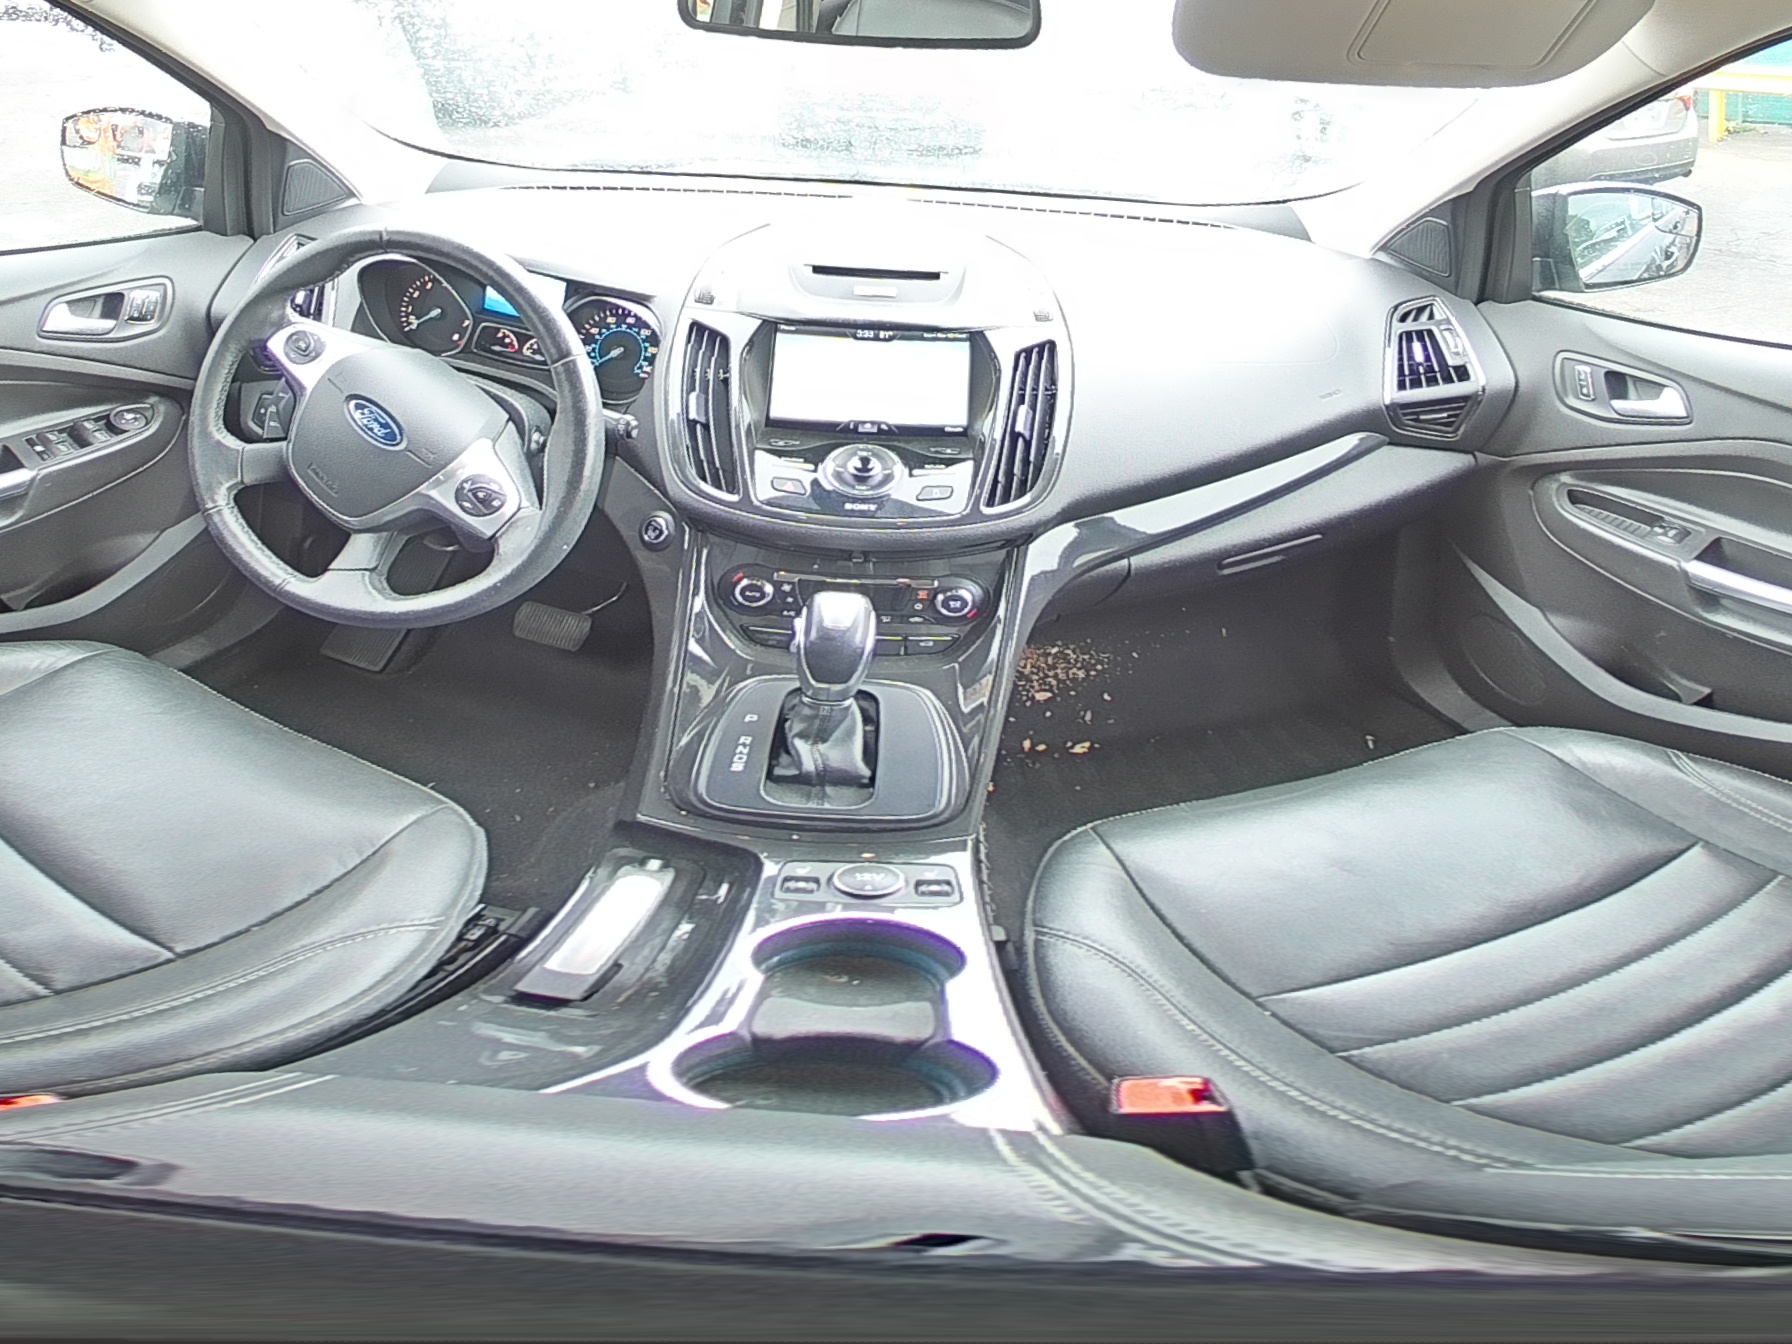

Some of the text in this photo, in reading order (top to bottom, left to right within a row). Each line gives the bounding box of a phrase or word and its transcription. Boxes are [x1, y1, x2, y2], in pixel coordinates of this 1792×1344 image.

[743, 713, 759, 723] P
[737, 735, 753, 744] R
[735, 744, 750, 754] N
